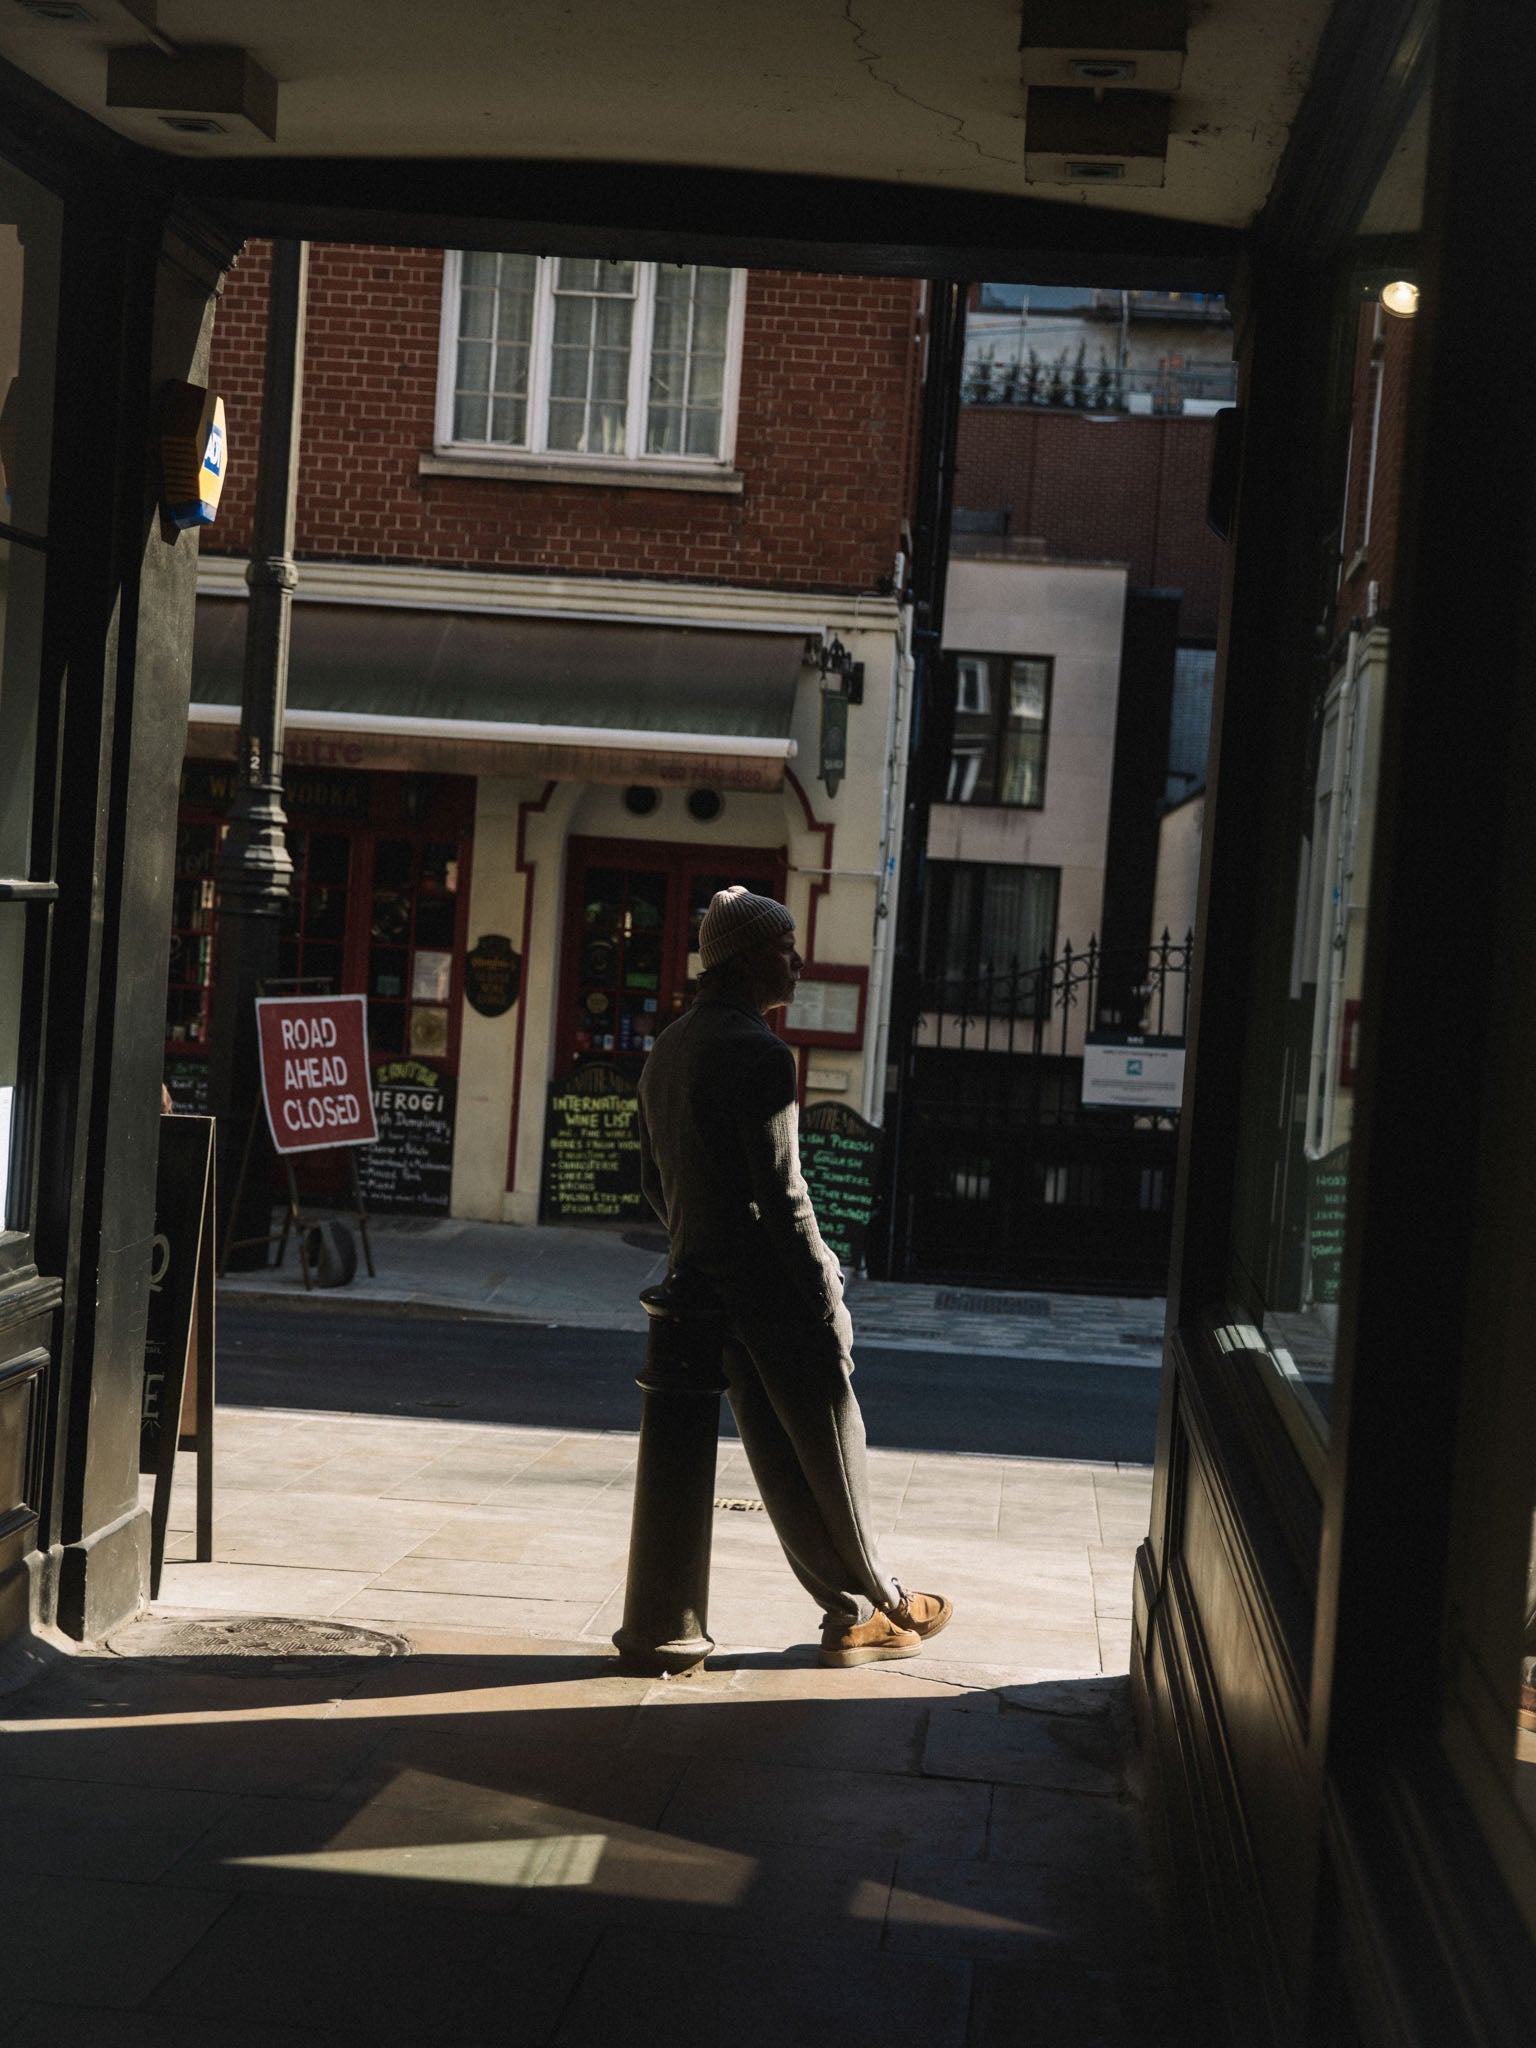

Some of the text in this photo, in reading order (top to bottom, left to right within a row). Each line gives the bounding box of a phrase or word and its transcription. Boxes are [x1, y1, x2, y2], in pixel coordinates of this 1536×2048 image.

[281, 1017, 337, 1050] ROAD
[284, 1056, 349, 1091] AHEAD
[283, 1094, 361, 1131] CLOSED
[374, 1091, 445, 1113] IEROGI
[564, 1112, 634, 1128] WINE LIST
